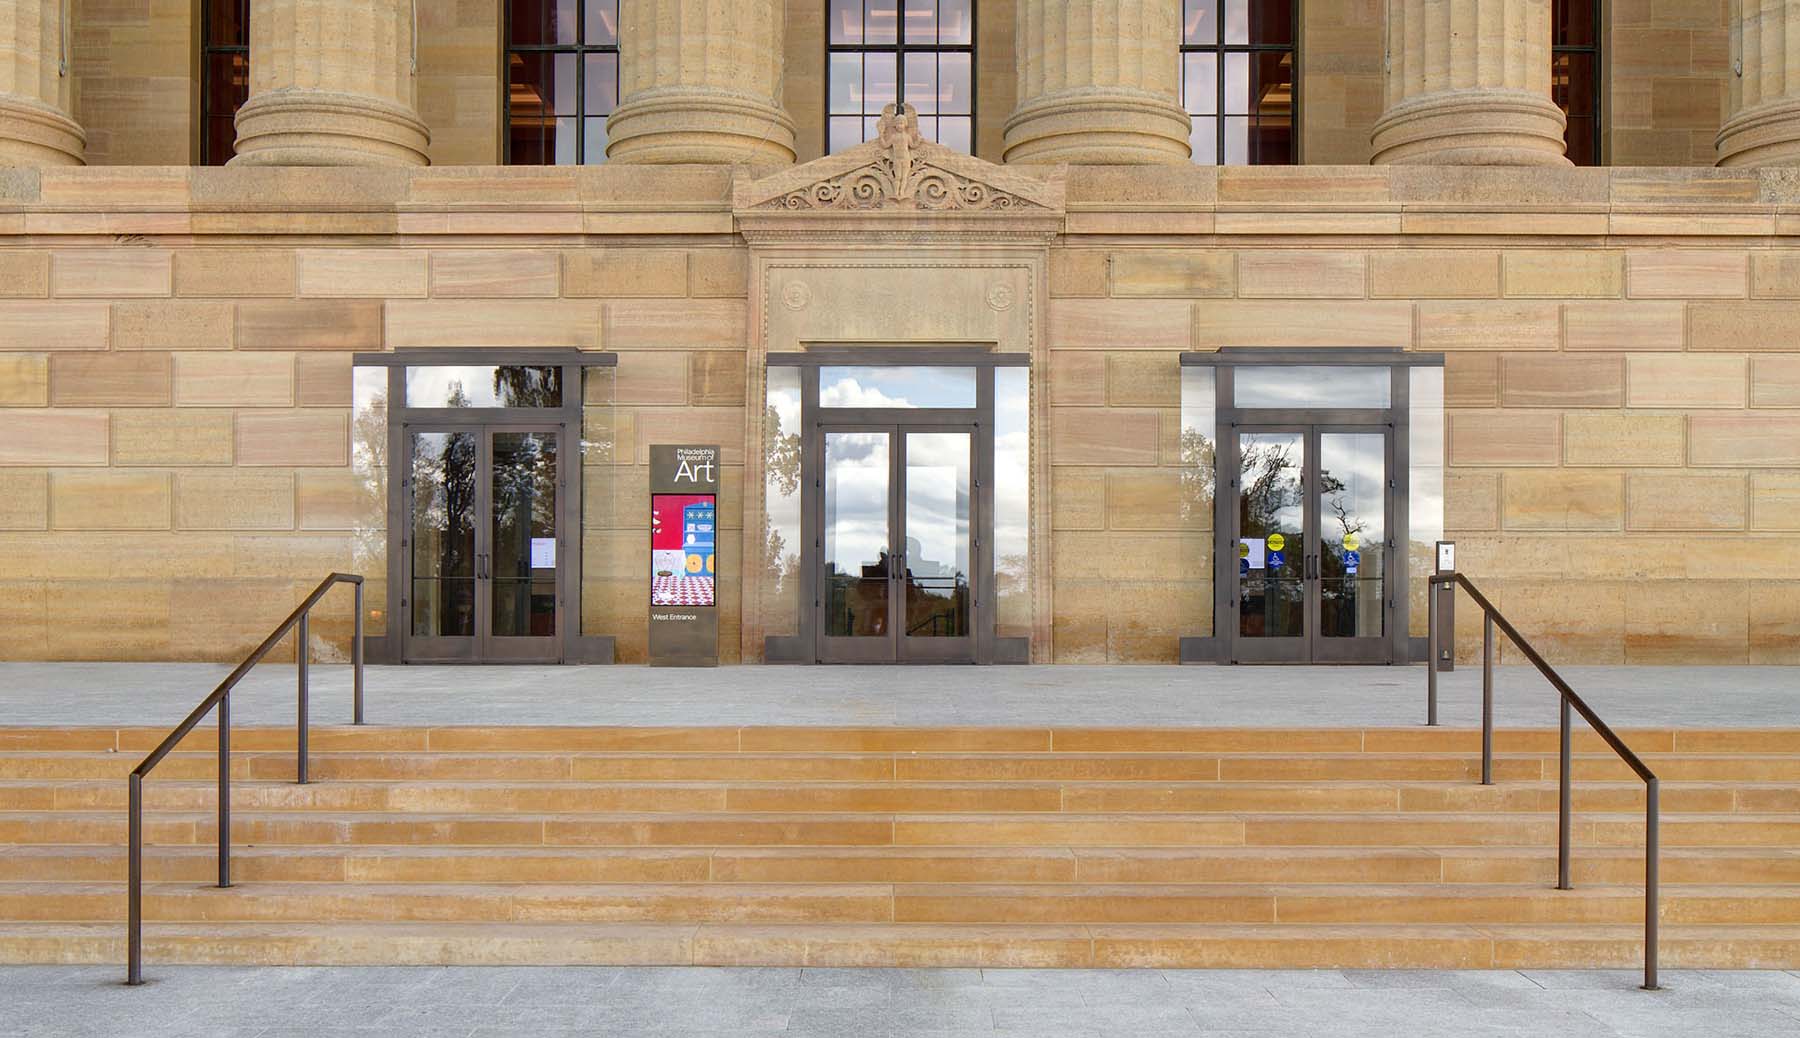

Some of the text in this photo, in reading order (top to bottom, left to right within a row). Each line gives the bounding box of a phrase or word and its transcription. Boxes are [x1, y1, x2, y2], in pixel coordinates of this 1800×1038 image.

[677, 448, 715, 457] Philadelphia
[673, 460, 715, 482] Art
[652, 613, 697, 621] West Entrance
